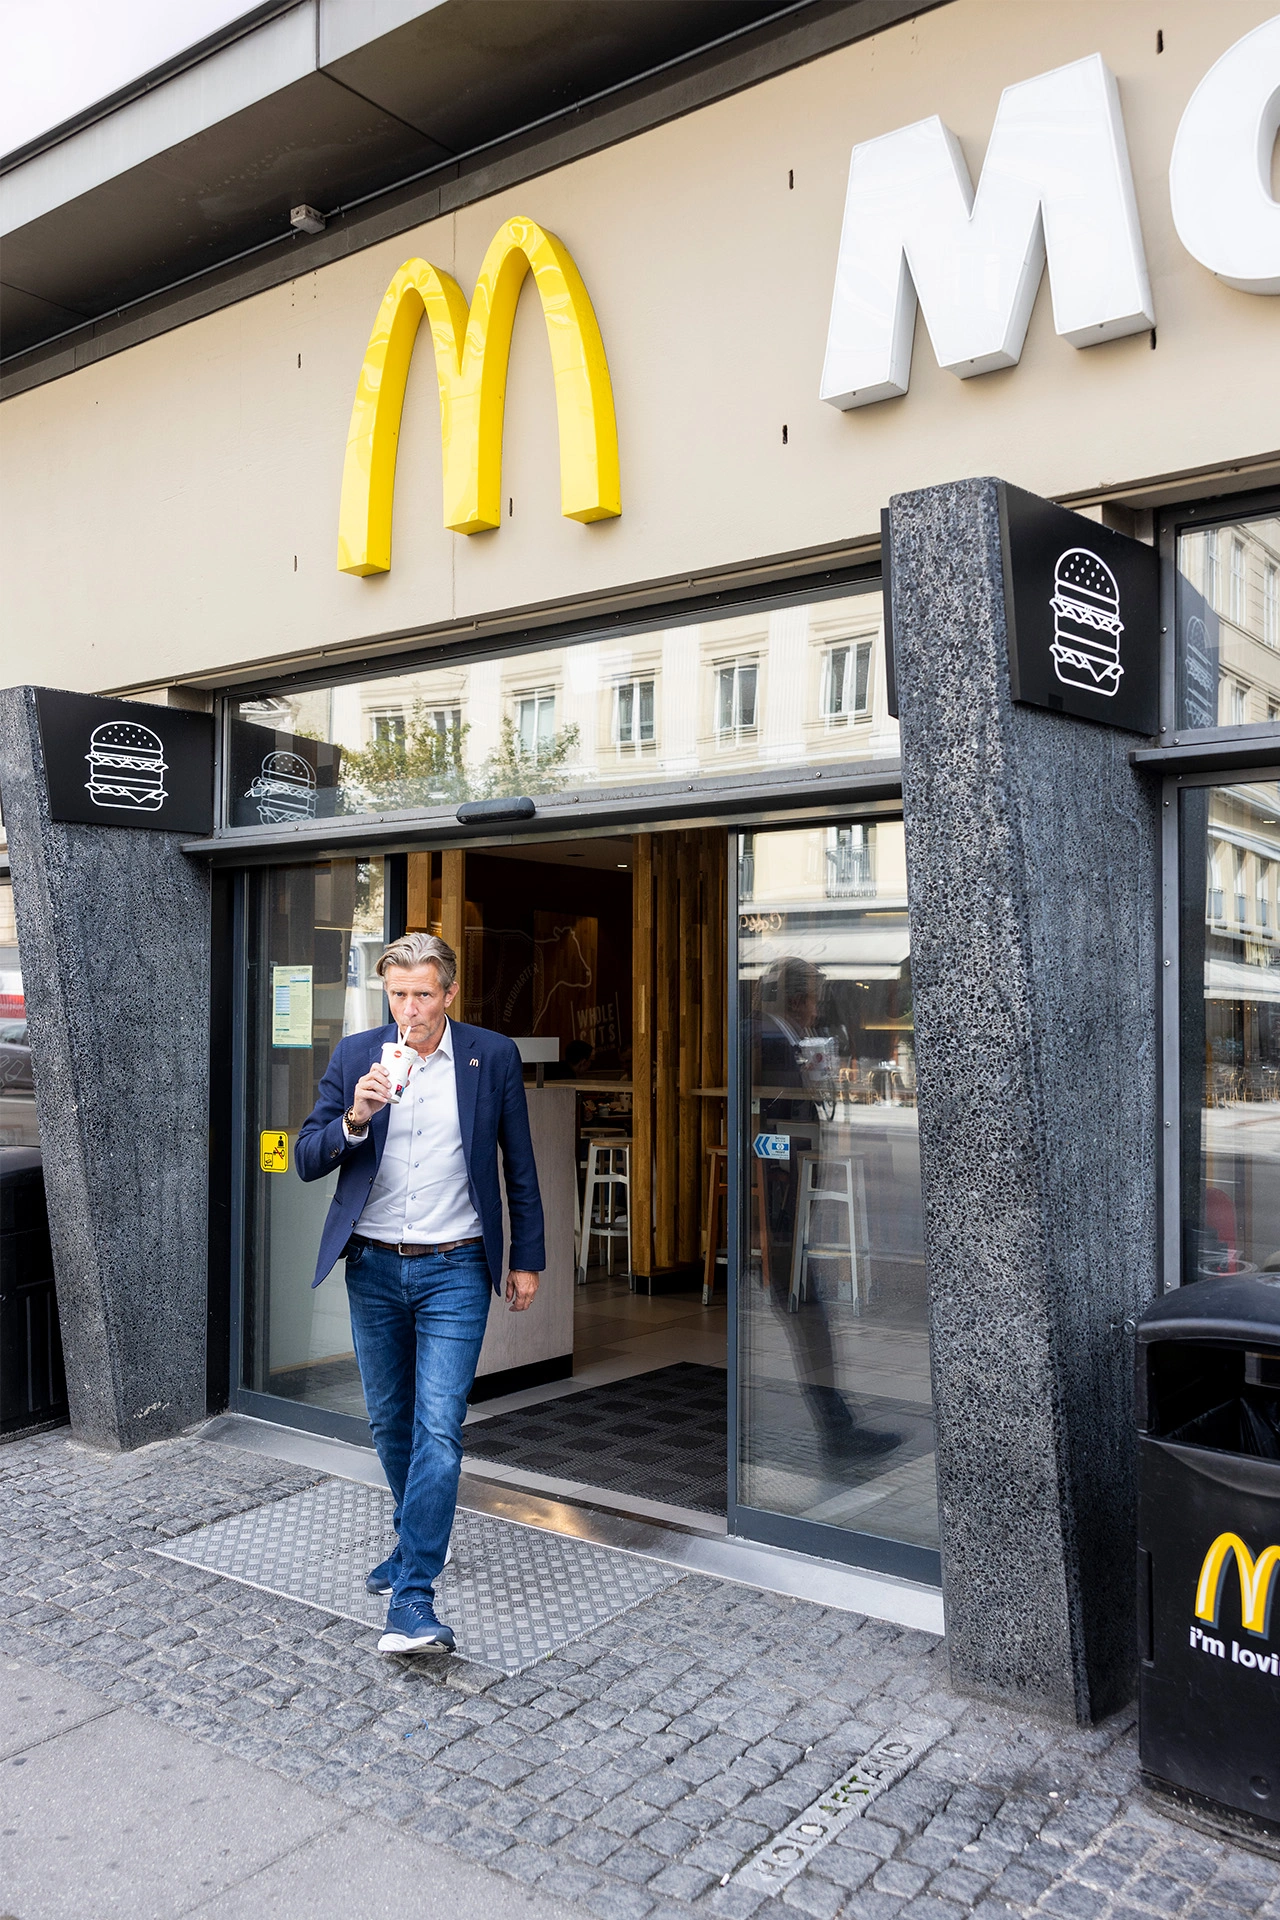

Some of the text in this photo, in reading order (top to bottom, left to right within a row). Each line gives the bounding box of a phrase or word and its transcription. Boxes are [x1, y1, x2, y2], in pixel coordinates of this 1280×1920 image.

[577, 1002, 614, 1029] WHOLE
[1190, 1625, 1280, 1677] i'm lovi
